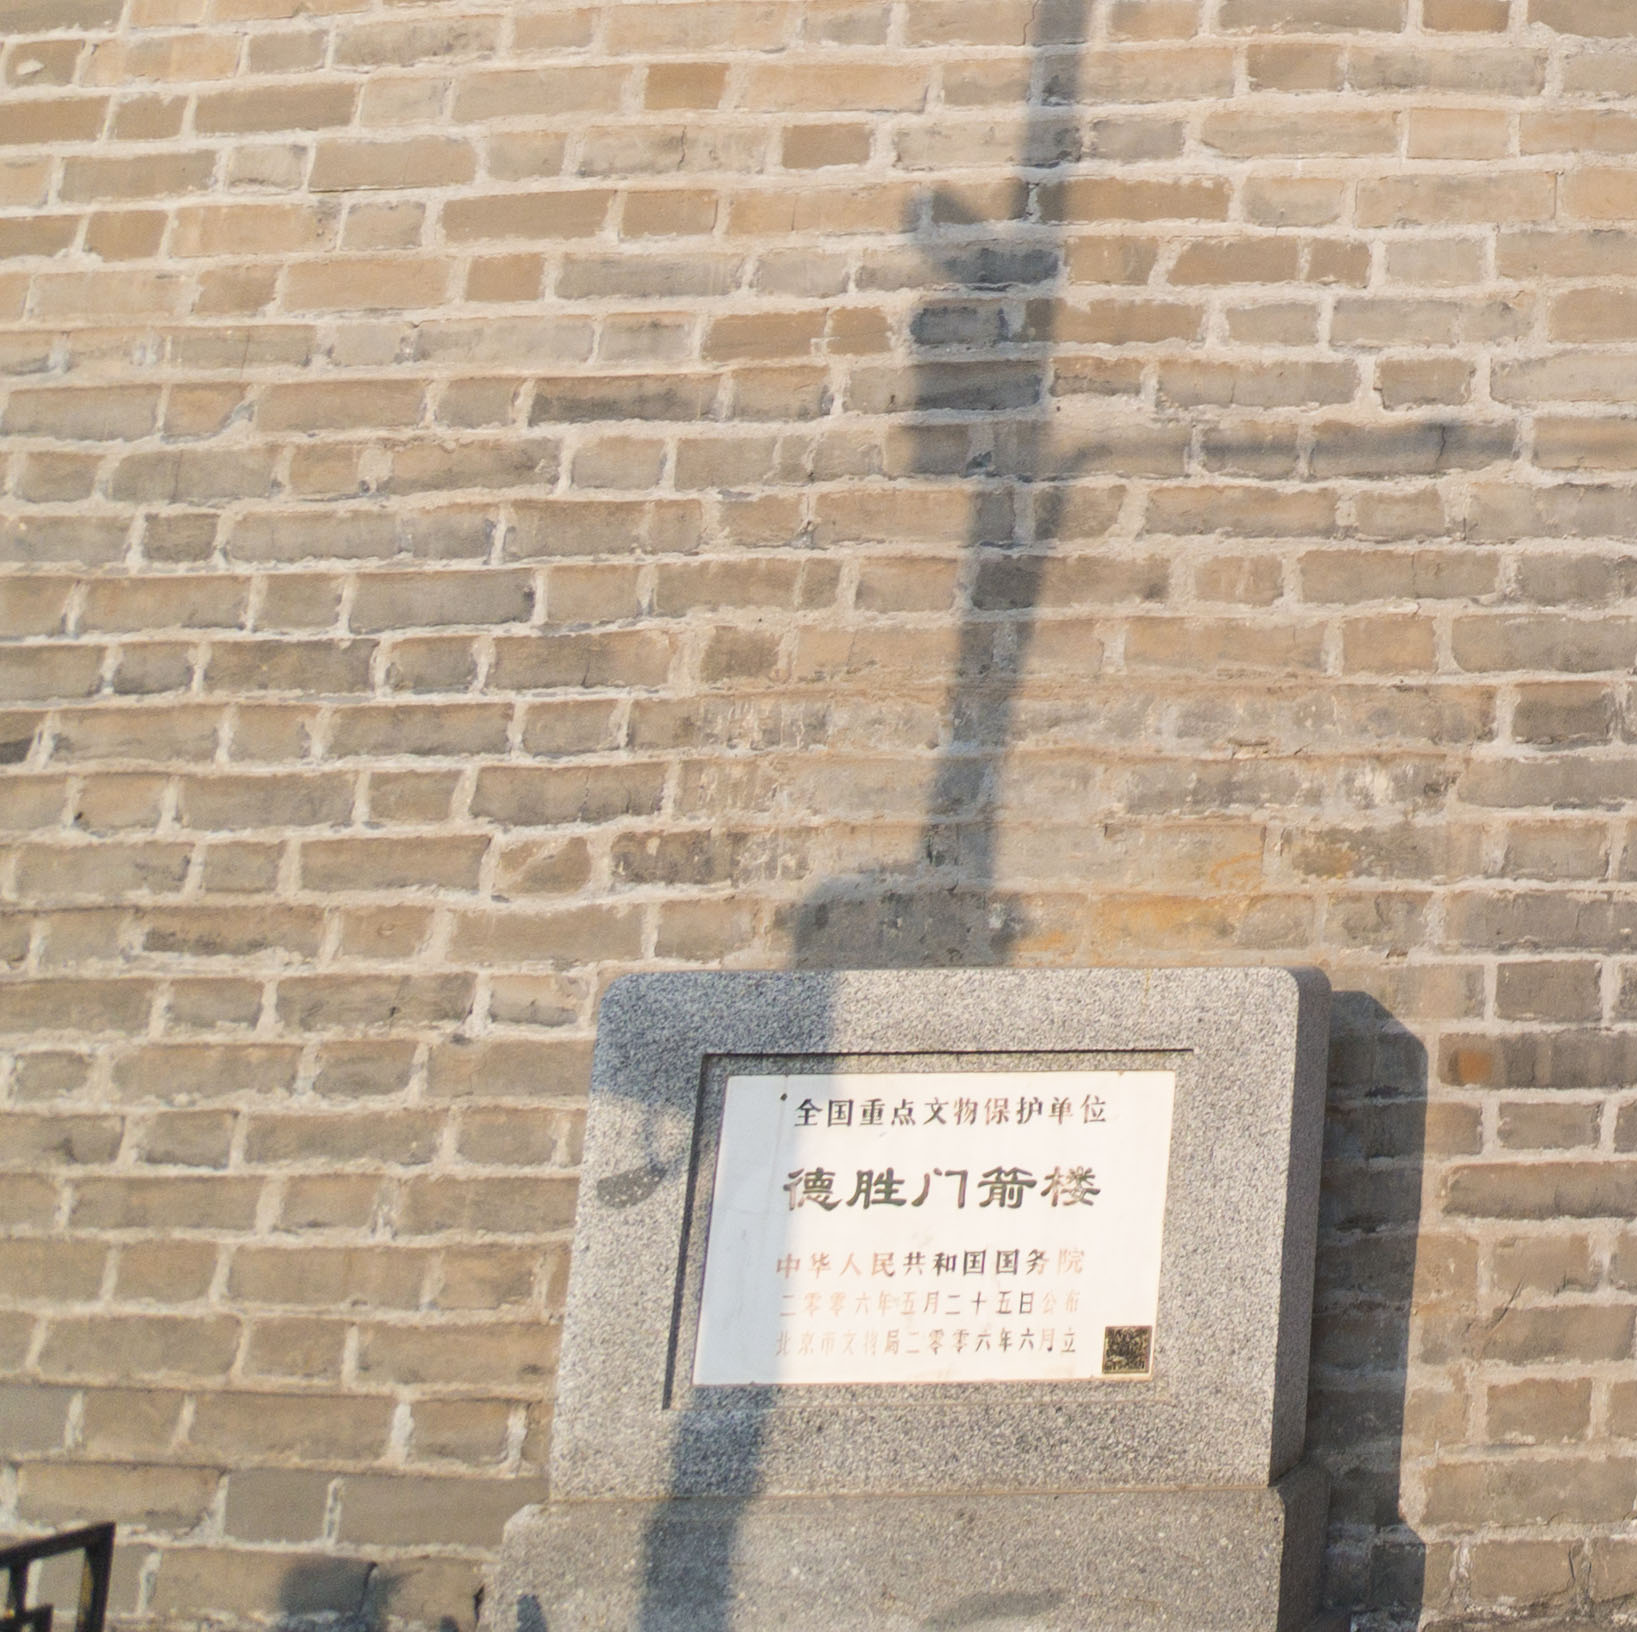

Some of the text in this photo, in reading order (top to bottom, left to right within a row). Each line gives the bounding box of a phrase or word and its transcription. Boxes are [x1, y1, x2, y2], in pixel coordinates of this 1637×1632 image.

[794, 1095, 1107, 1126] 全国重点文物保护单位
[783, 1165, 1101, 1211] 德胜门箭楼
[776, 1248, 1085, 1279] 中华人民共和国国务院
[779, 1290, 1080, 1317] 二零零六年五月二十五日公布
